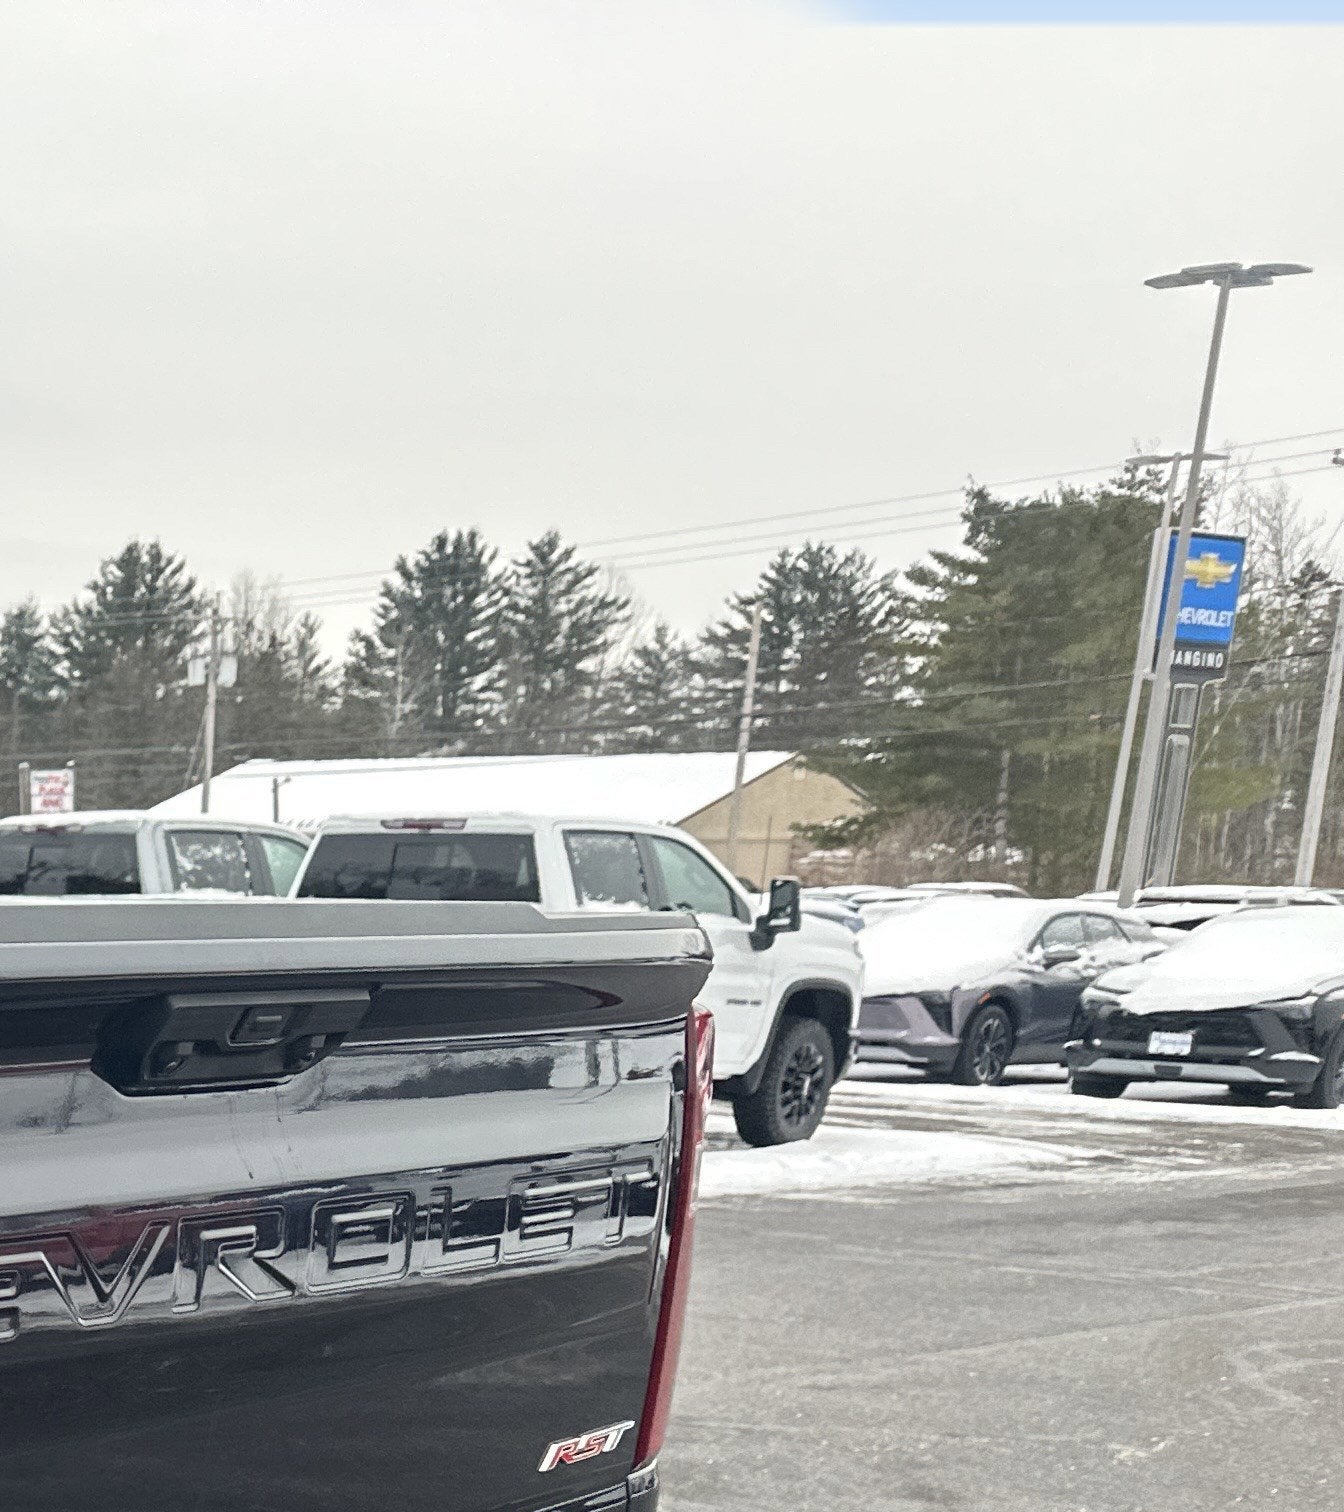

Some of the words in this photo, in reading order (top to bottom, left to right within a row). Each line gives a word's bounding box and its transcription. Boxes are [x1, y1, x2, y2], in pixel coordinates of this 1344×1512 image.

[1176, 606, 1234, 627] HEVROLET
[1171, 650, 1224, 669] ANGINO
[537, 1420, 636, 1472] RST
